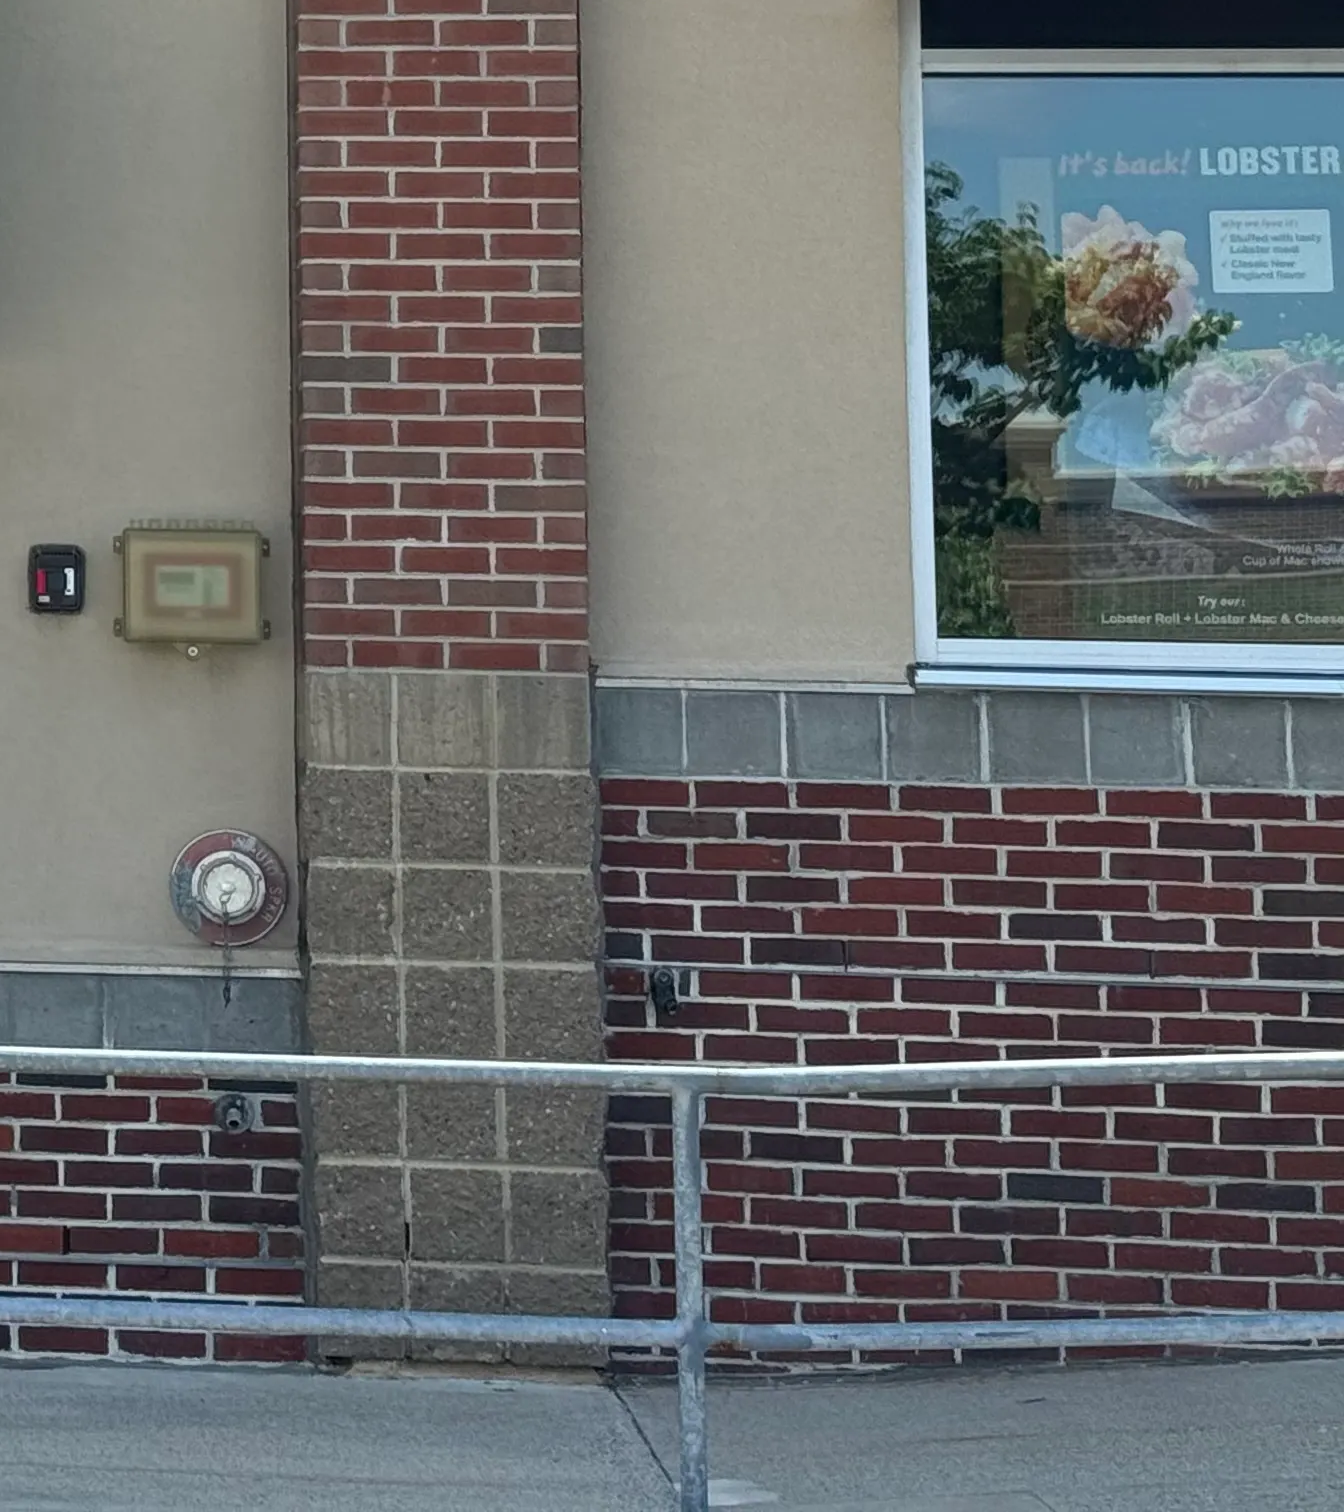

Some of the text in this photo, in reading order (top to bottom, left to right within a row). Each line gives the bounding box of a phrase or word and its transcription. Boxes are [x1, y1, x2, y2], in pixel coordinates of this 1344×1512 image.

[1058, 145, 1342, 177] It's back! LOBSTER
[1242, 555, 1267, 567] Cup
[1269, 555, 1281, 566] of
[1197, 595, 1217, 608] Try
[1101, 613, 1153, 625] Lobster
[1154, 613, 1181, 625] Roll
[1194, 613, 1246, 625] Lobster
[1249, 613, 1277, 625] Mac
[1280, 614, 1292, 625] &
